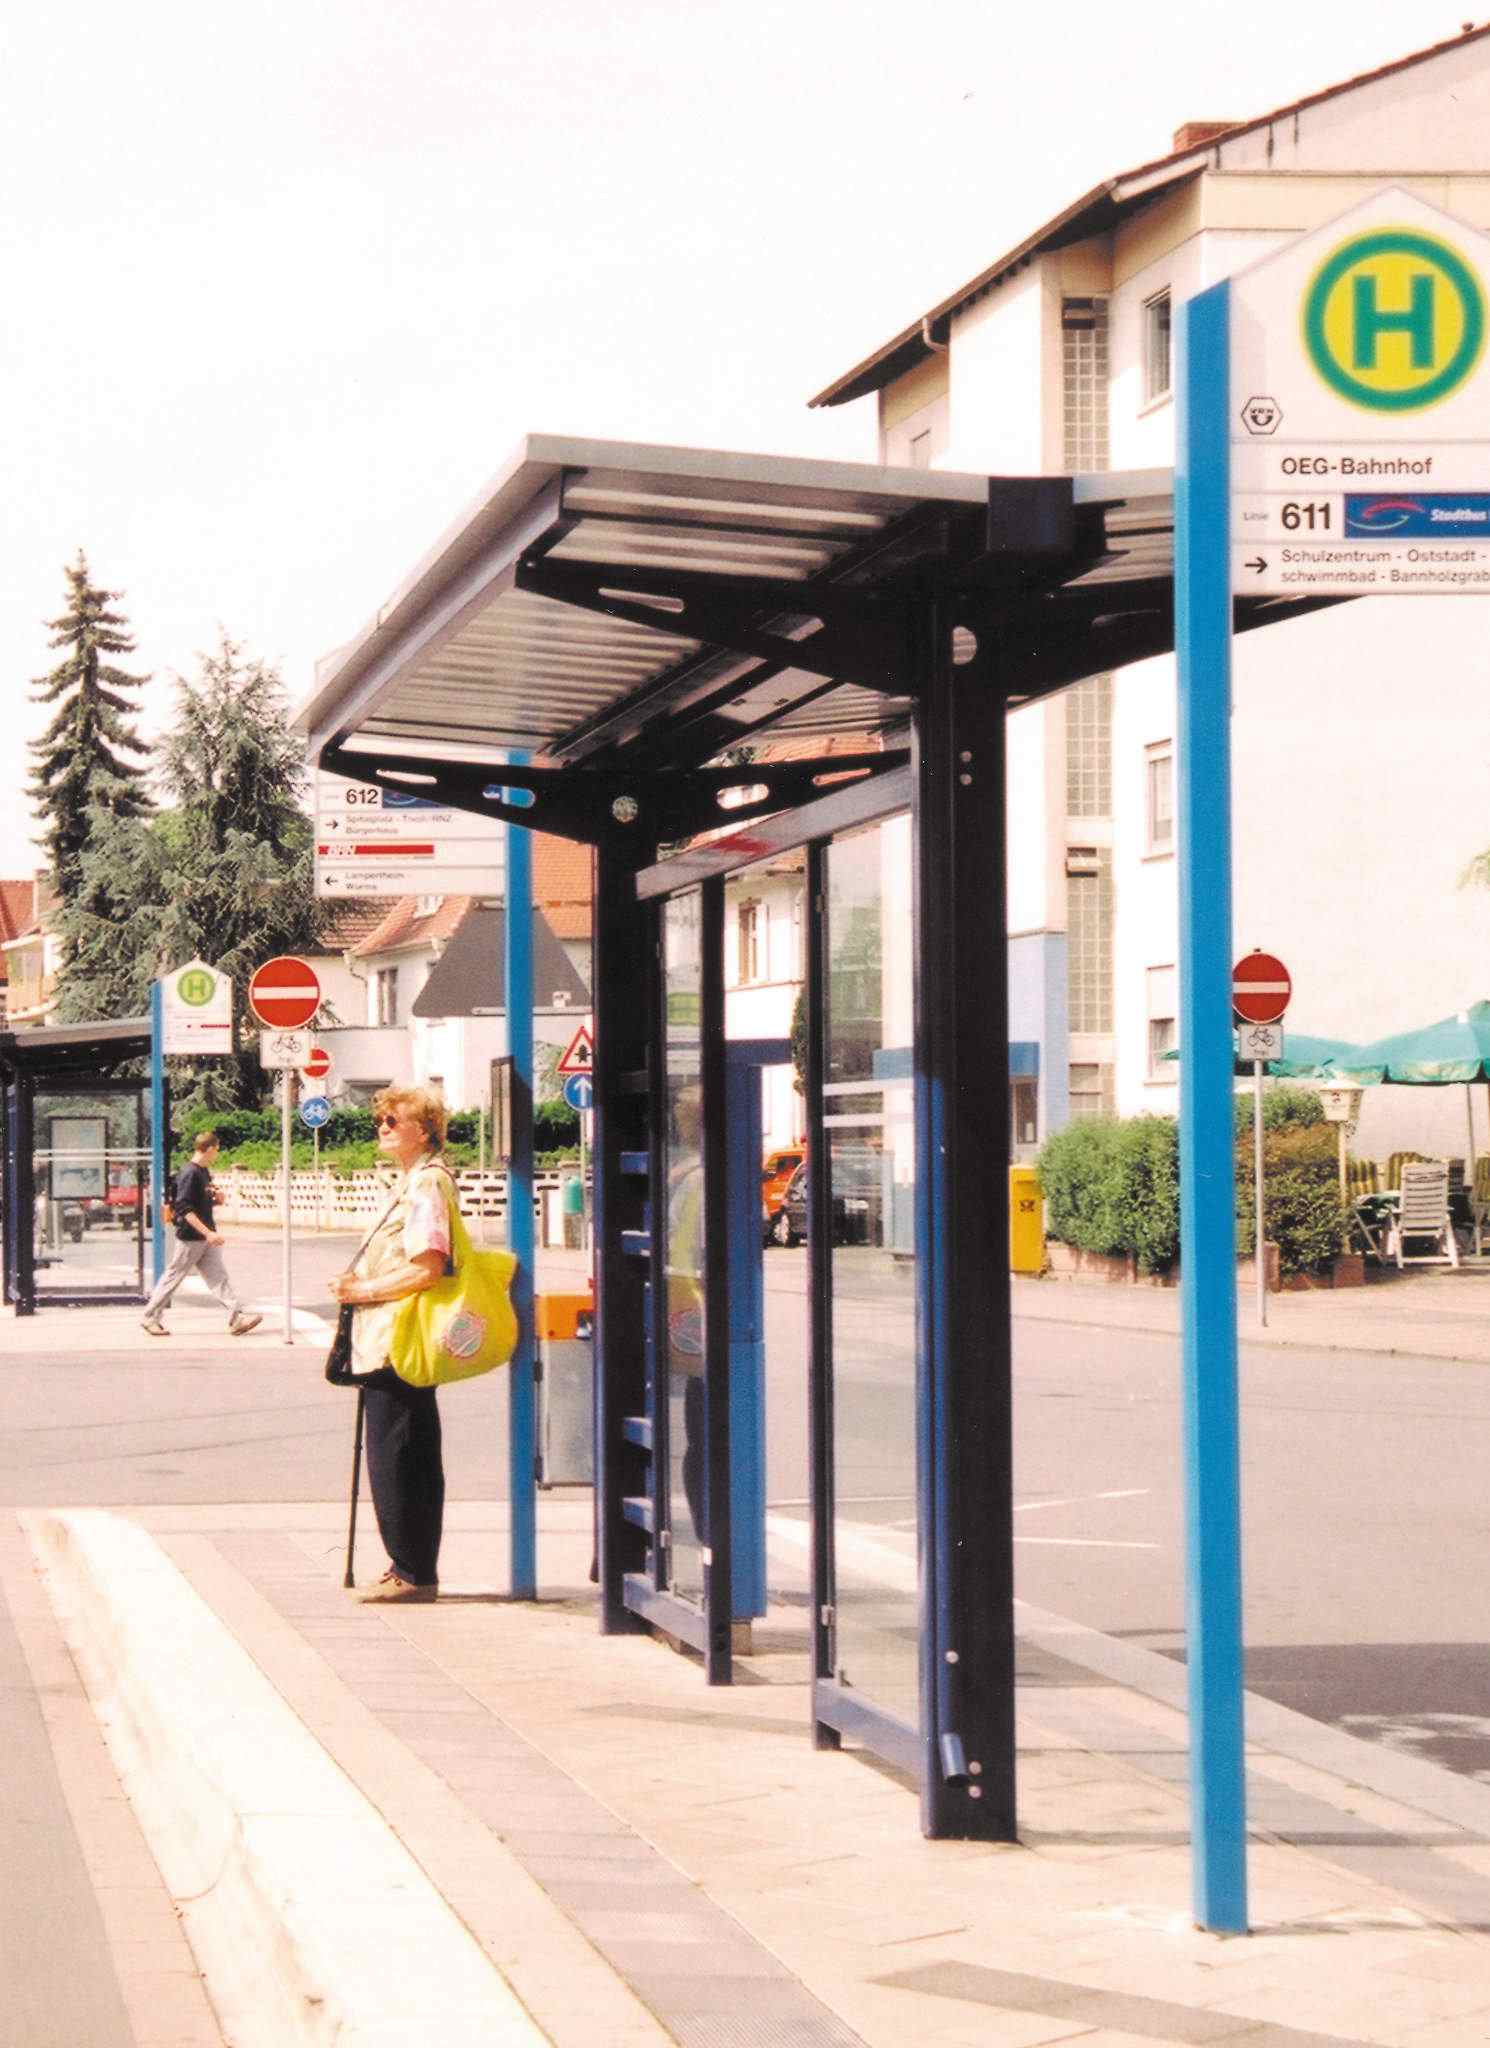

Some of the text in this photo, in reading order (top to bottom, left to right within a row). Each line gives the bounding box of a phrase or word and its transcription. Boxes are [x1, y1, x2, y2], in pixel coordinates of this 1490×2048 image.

[1353, 274, 1434, 369] H
[1281, 456, 1432, 475] OEG-Bahnhof
[1281, 502, 1330, 530] 611
[1281, 547, 1392, 563] Schulzentrum
[1407, 548, 1476, 563] Oststadt
[1281, 569, 1376, 583] schwimmbad
[346, 788, 379, 805] 612
